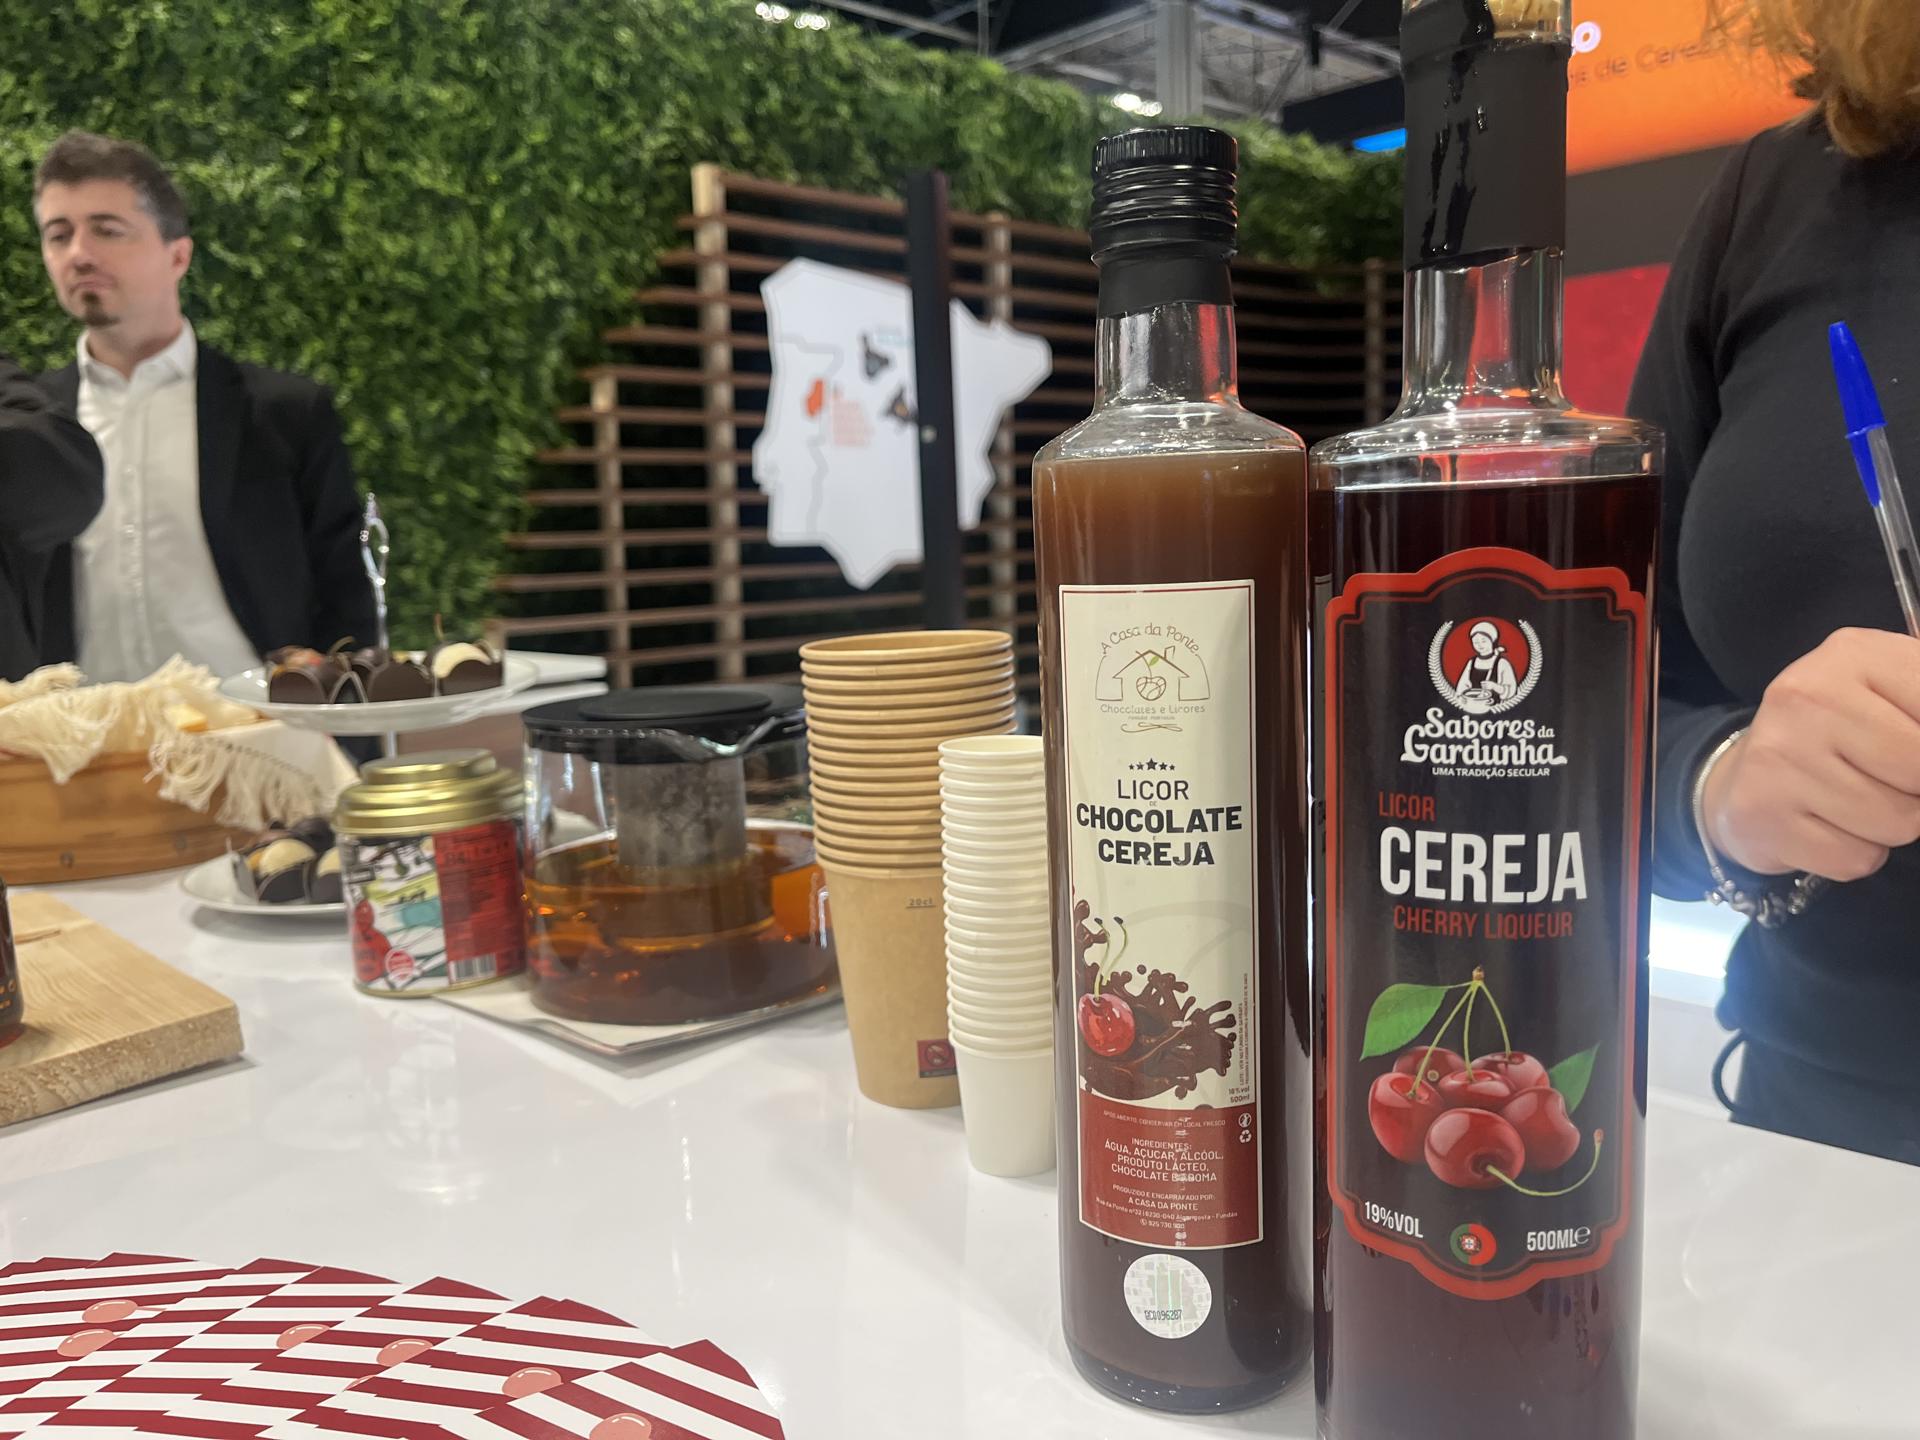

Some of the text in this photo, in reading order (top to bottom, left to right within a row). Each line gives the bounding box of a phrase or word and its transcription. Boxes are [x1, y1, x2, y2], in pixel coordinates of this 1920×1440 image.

[1101, 623, 1200, 655] A Casa da Ponte
[1159, 706, 1167, 714] e
[1424, 707, 1556, 740] Sabores da
[1400, 724, 1568, 766] Gardunha
[1431, 766, 1551, 780] UMA TRADIÇÃO SECULAR
[1117, 779, 1189, 800] LICOR
[1076, 803, 1242, 834] CHOCOLATE
[1378, 791, 1436, 822] LICOR
[1098, 838, 1215, 866] CEREJA
[1380, 826, 1588, 904] CEREJA
[1393, 905, 1574, 941] CHERRY LIQUEUR
[1104, 1138, 1132, 1156] ÁGUA,
[1131, 1137, 1192, 1151] INGREDIENTES:
[1111, 1163, 1169, 1181] CHOCOLATE
[1117, 1154, 1209, 1172] PRODUTO LÁCTEO,
[1128, 1196, 1199, 1211] A CASA DA PONTE
[1364, 1200, 1424, 1239] 19%VOL
